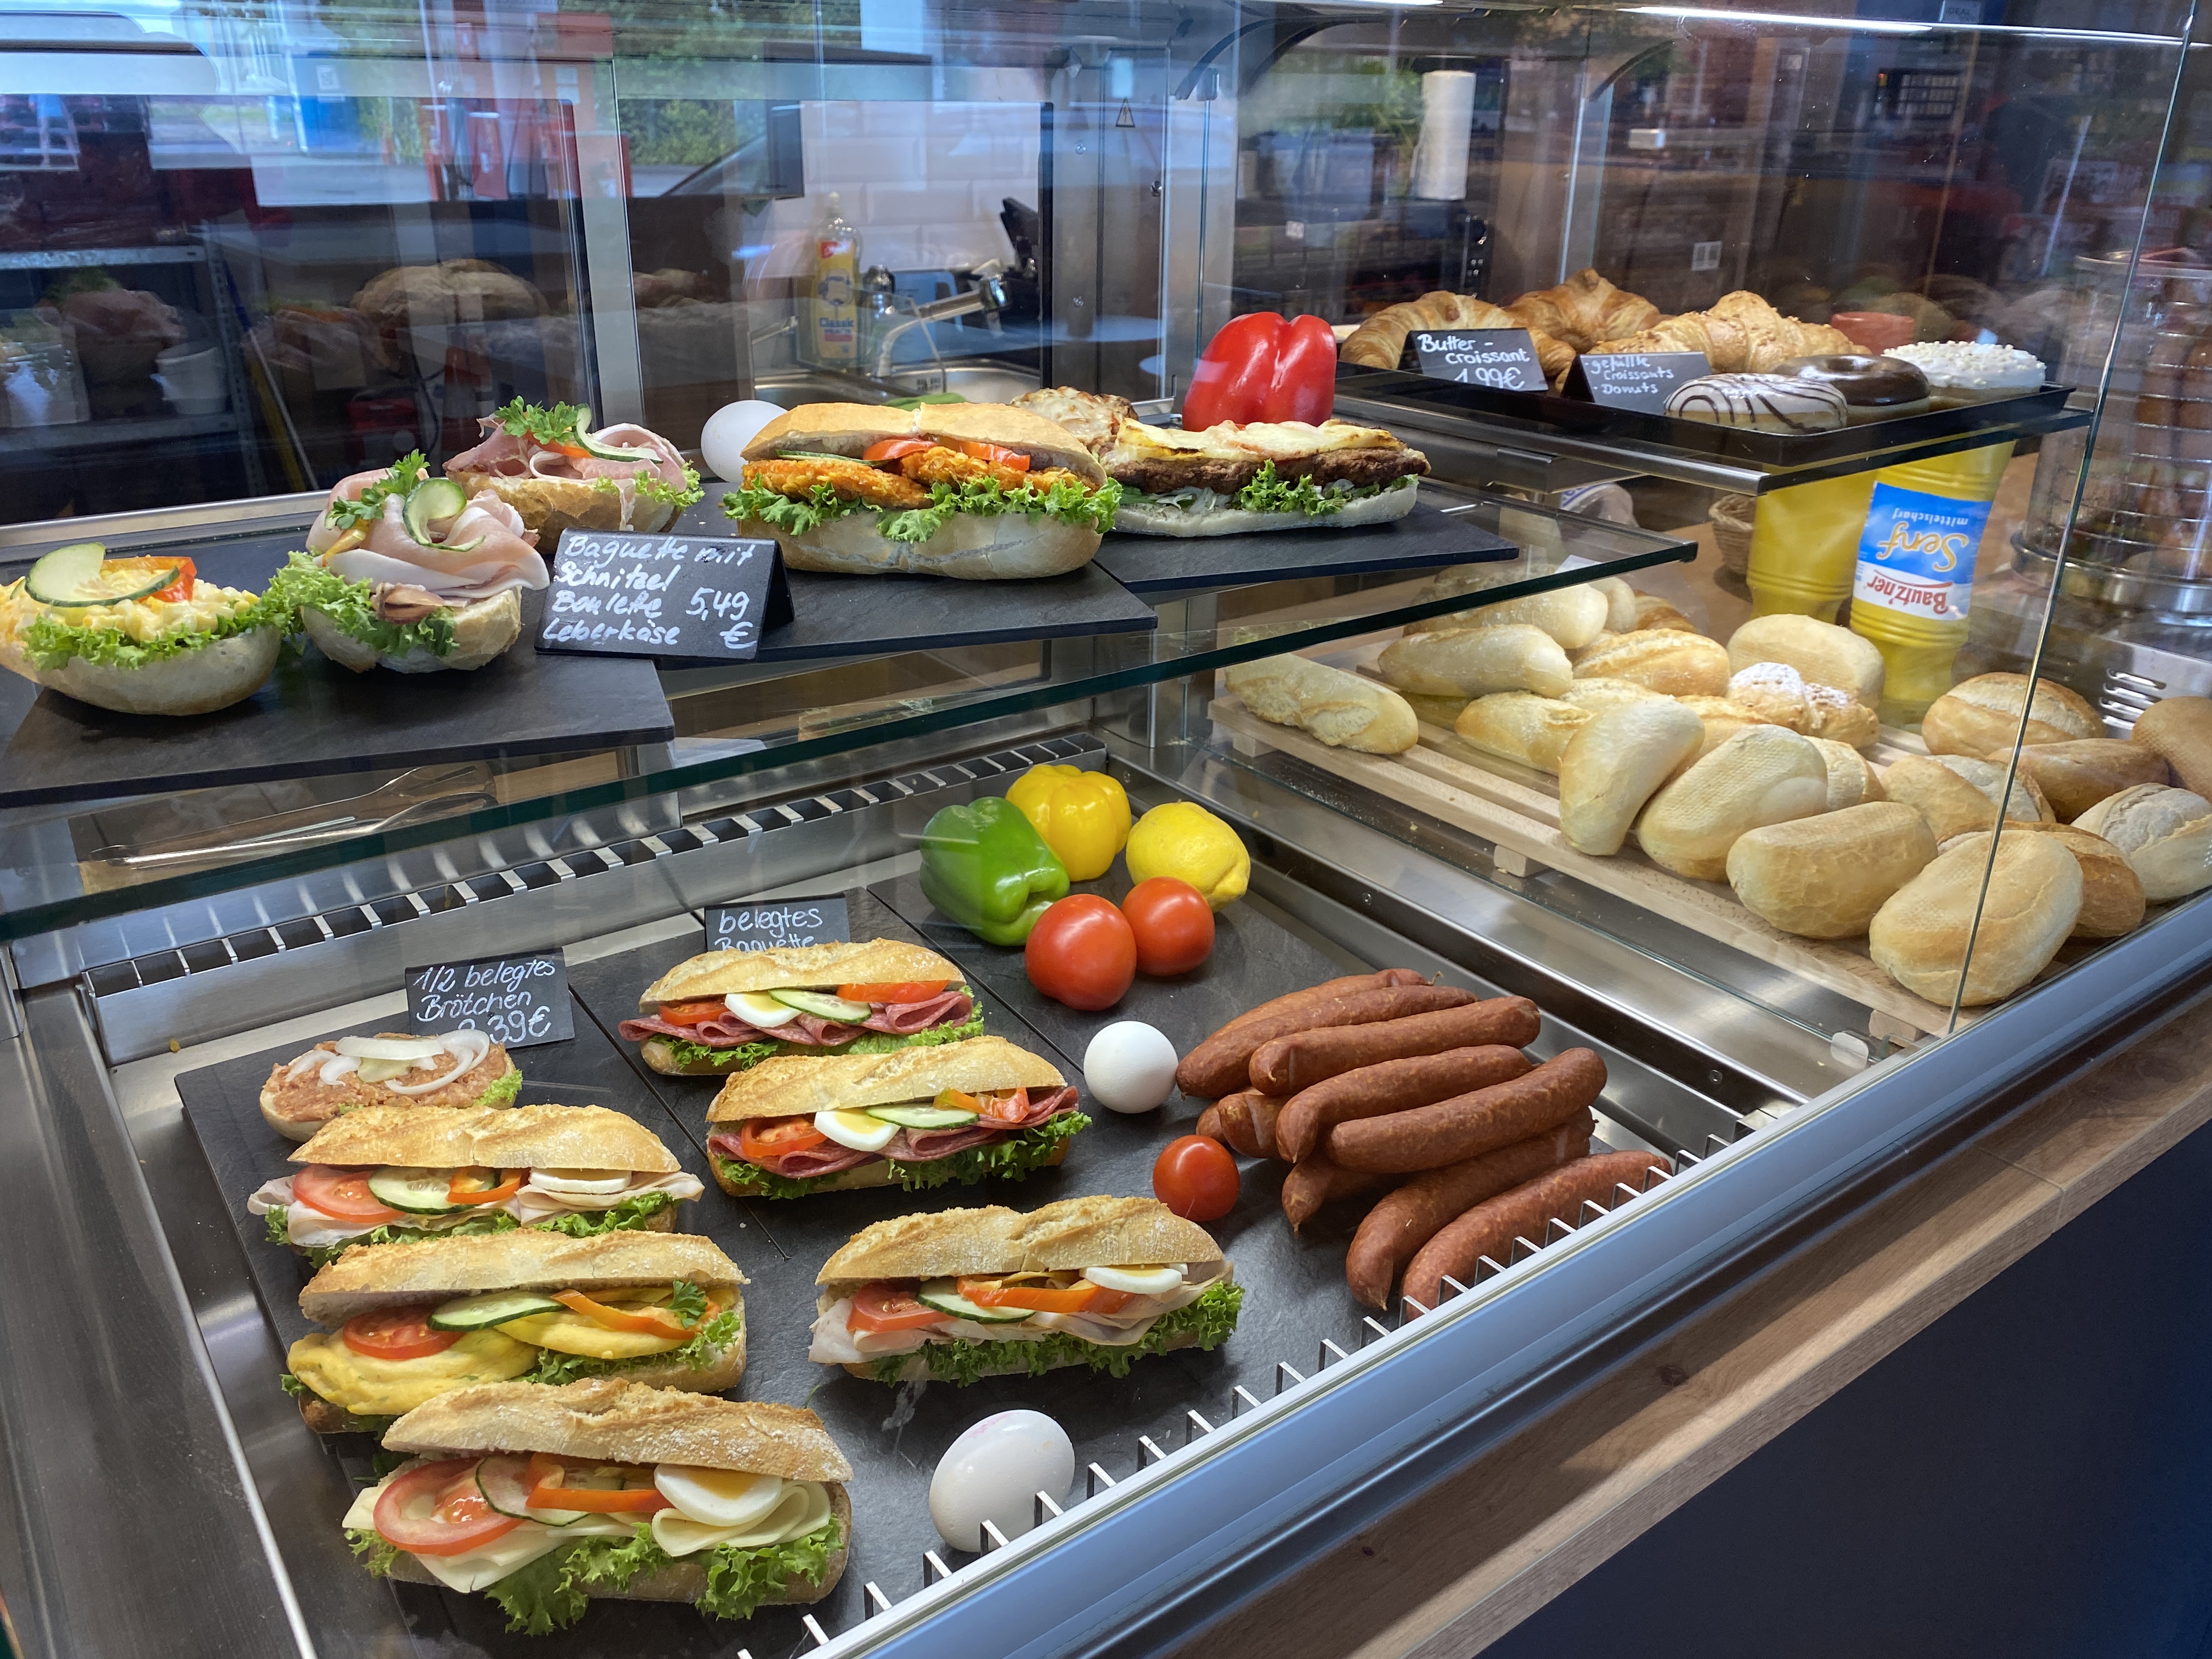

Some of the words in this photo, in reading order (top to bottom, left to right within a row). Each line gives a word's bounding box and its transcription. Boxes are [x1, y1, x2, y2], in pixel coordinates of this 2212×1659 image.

[1417, 334, 1476, 352] Butter
[1600, 382, 1659, 394] Donuts
[1891, 507, 1970, 527] mittelscharf
[565, 535, 688, 568] Baguette
[693, 544, 755, 566] mit
[1875, 521, 1970, 573] Senf
[554, 560, 682, 591] Schnitzel
[685, 587, 750, 620] 5,49
[542, 617, 681, 645] Leberkäse
[719, 621, 758, 649] €
[719, 906, 823, 938] belegtes
[413, 965, 456, 993] 1/2
[464, 958, 556, 992] belegtes
[416, 991, 532, 1022] Brötchen
